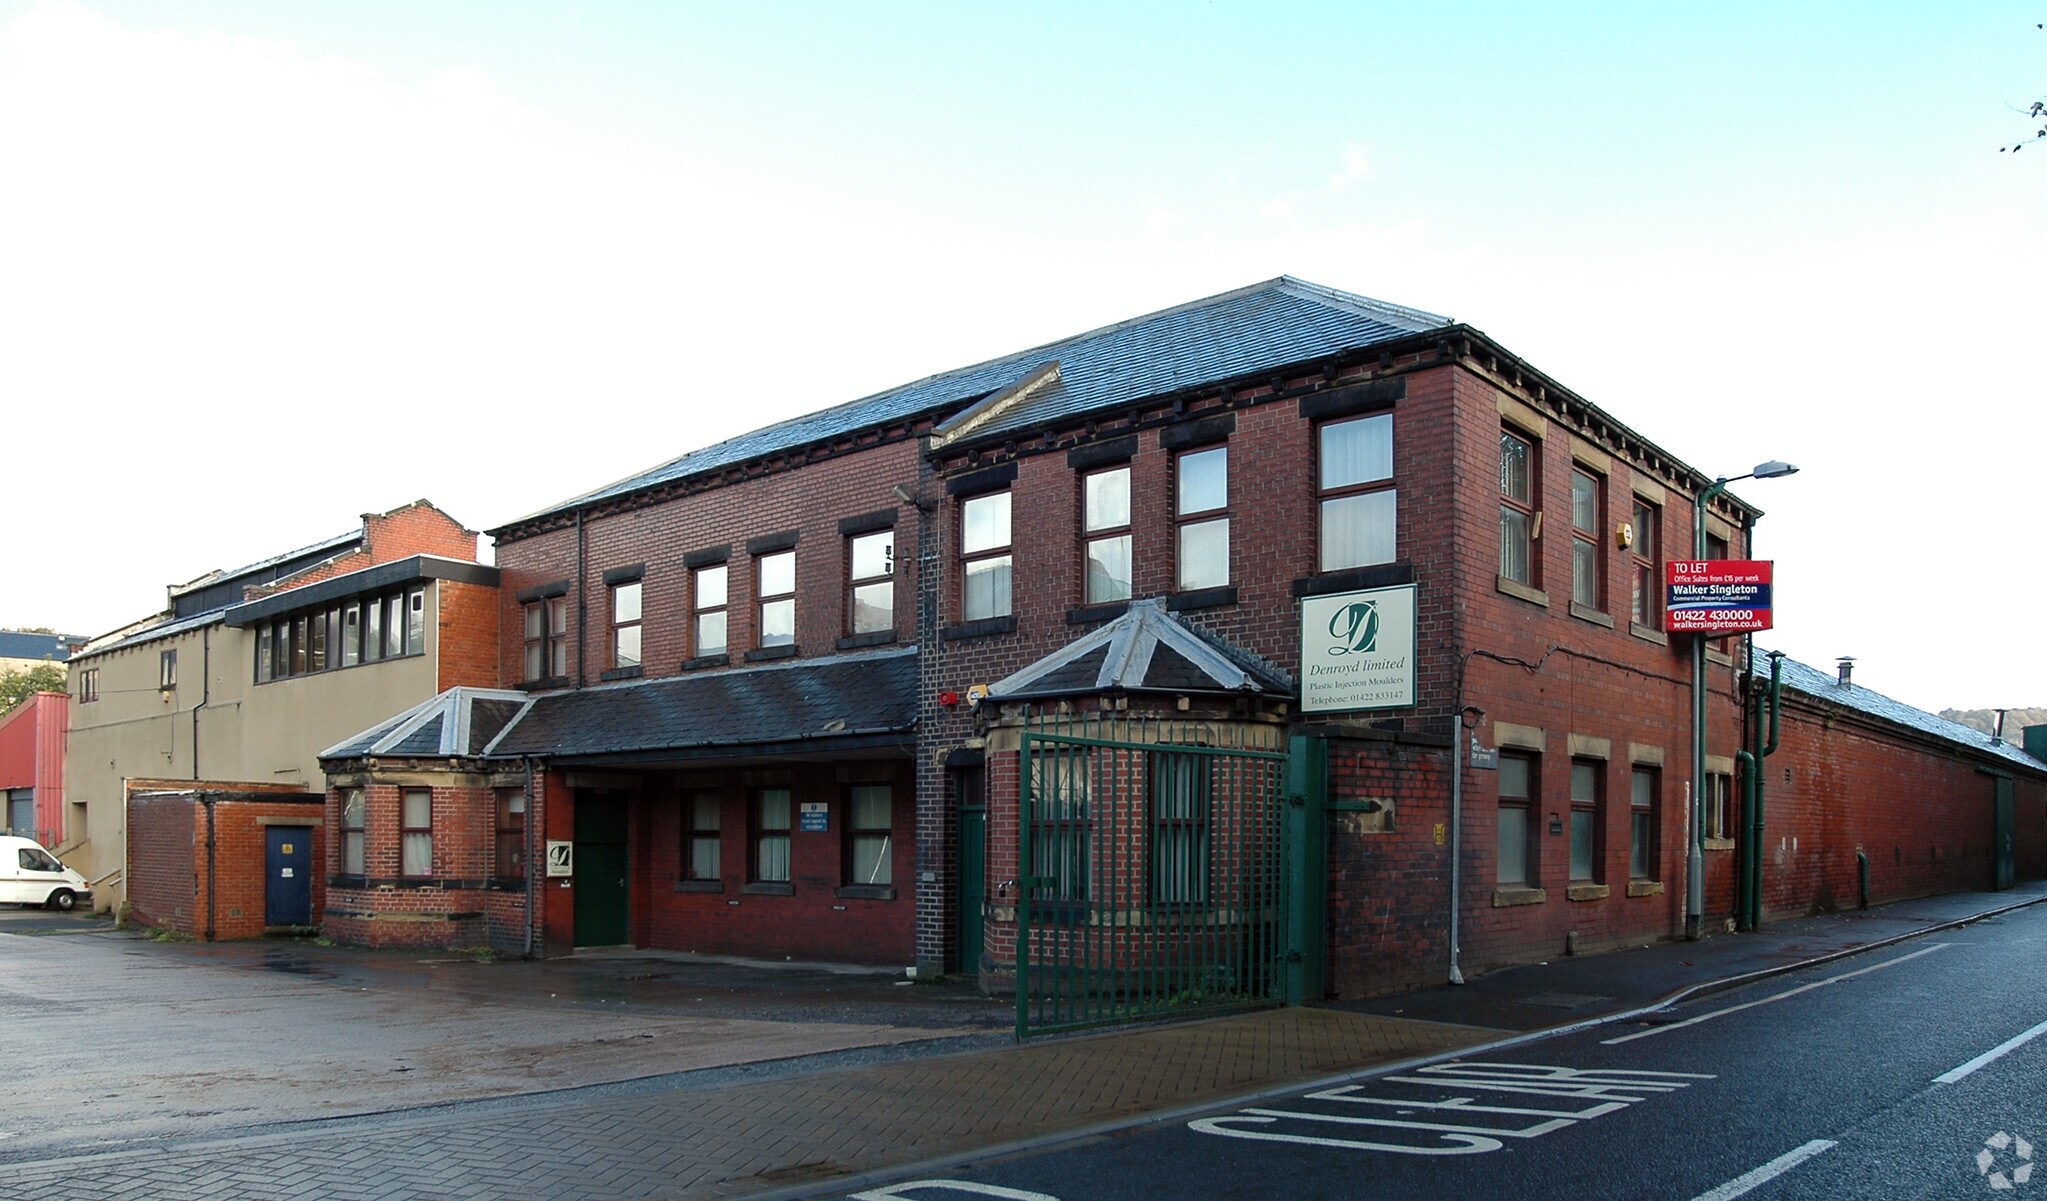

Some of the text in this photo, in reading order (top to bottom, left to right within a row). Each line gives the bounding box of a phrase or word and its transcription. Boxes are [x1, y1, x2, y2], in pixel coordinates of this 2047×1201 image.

[1675, 563, 1708, 573] TO LET
[1674, 575, 1691, 583] Office
[1673, 585, 1757, 595] Walker Singleton
[1673, 610, 1753, 621] 01422 430000
[1673, 620, 1763, 629] walkersingleton.co.uk
[1310, 657, 1405, 676] Denroyd limited
[1310, 677, 1404, 691] Plastic Injection Moulders
[1311, 691, 1403, 706] Telephone: 01422 833147
[1187, 1062, 1717, 1156] CLEAR
